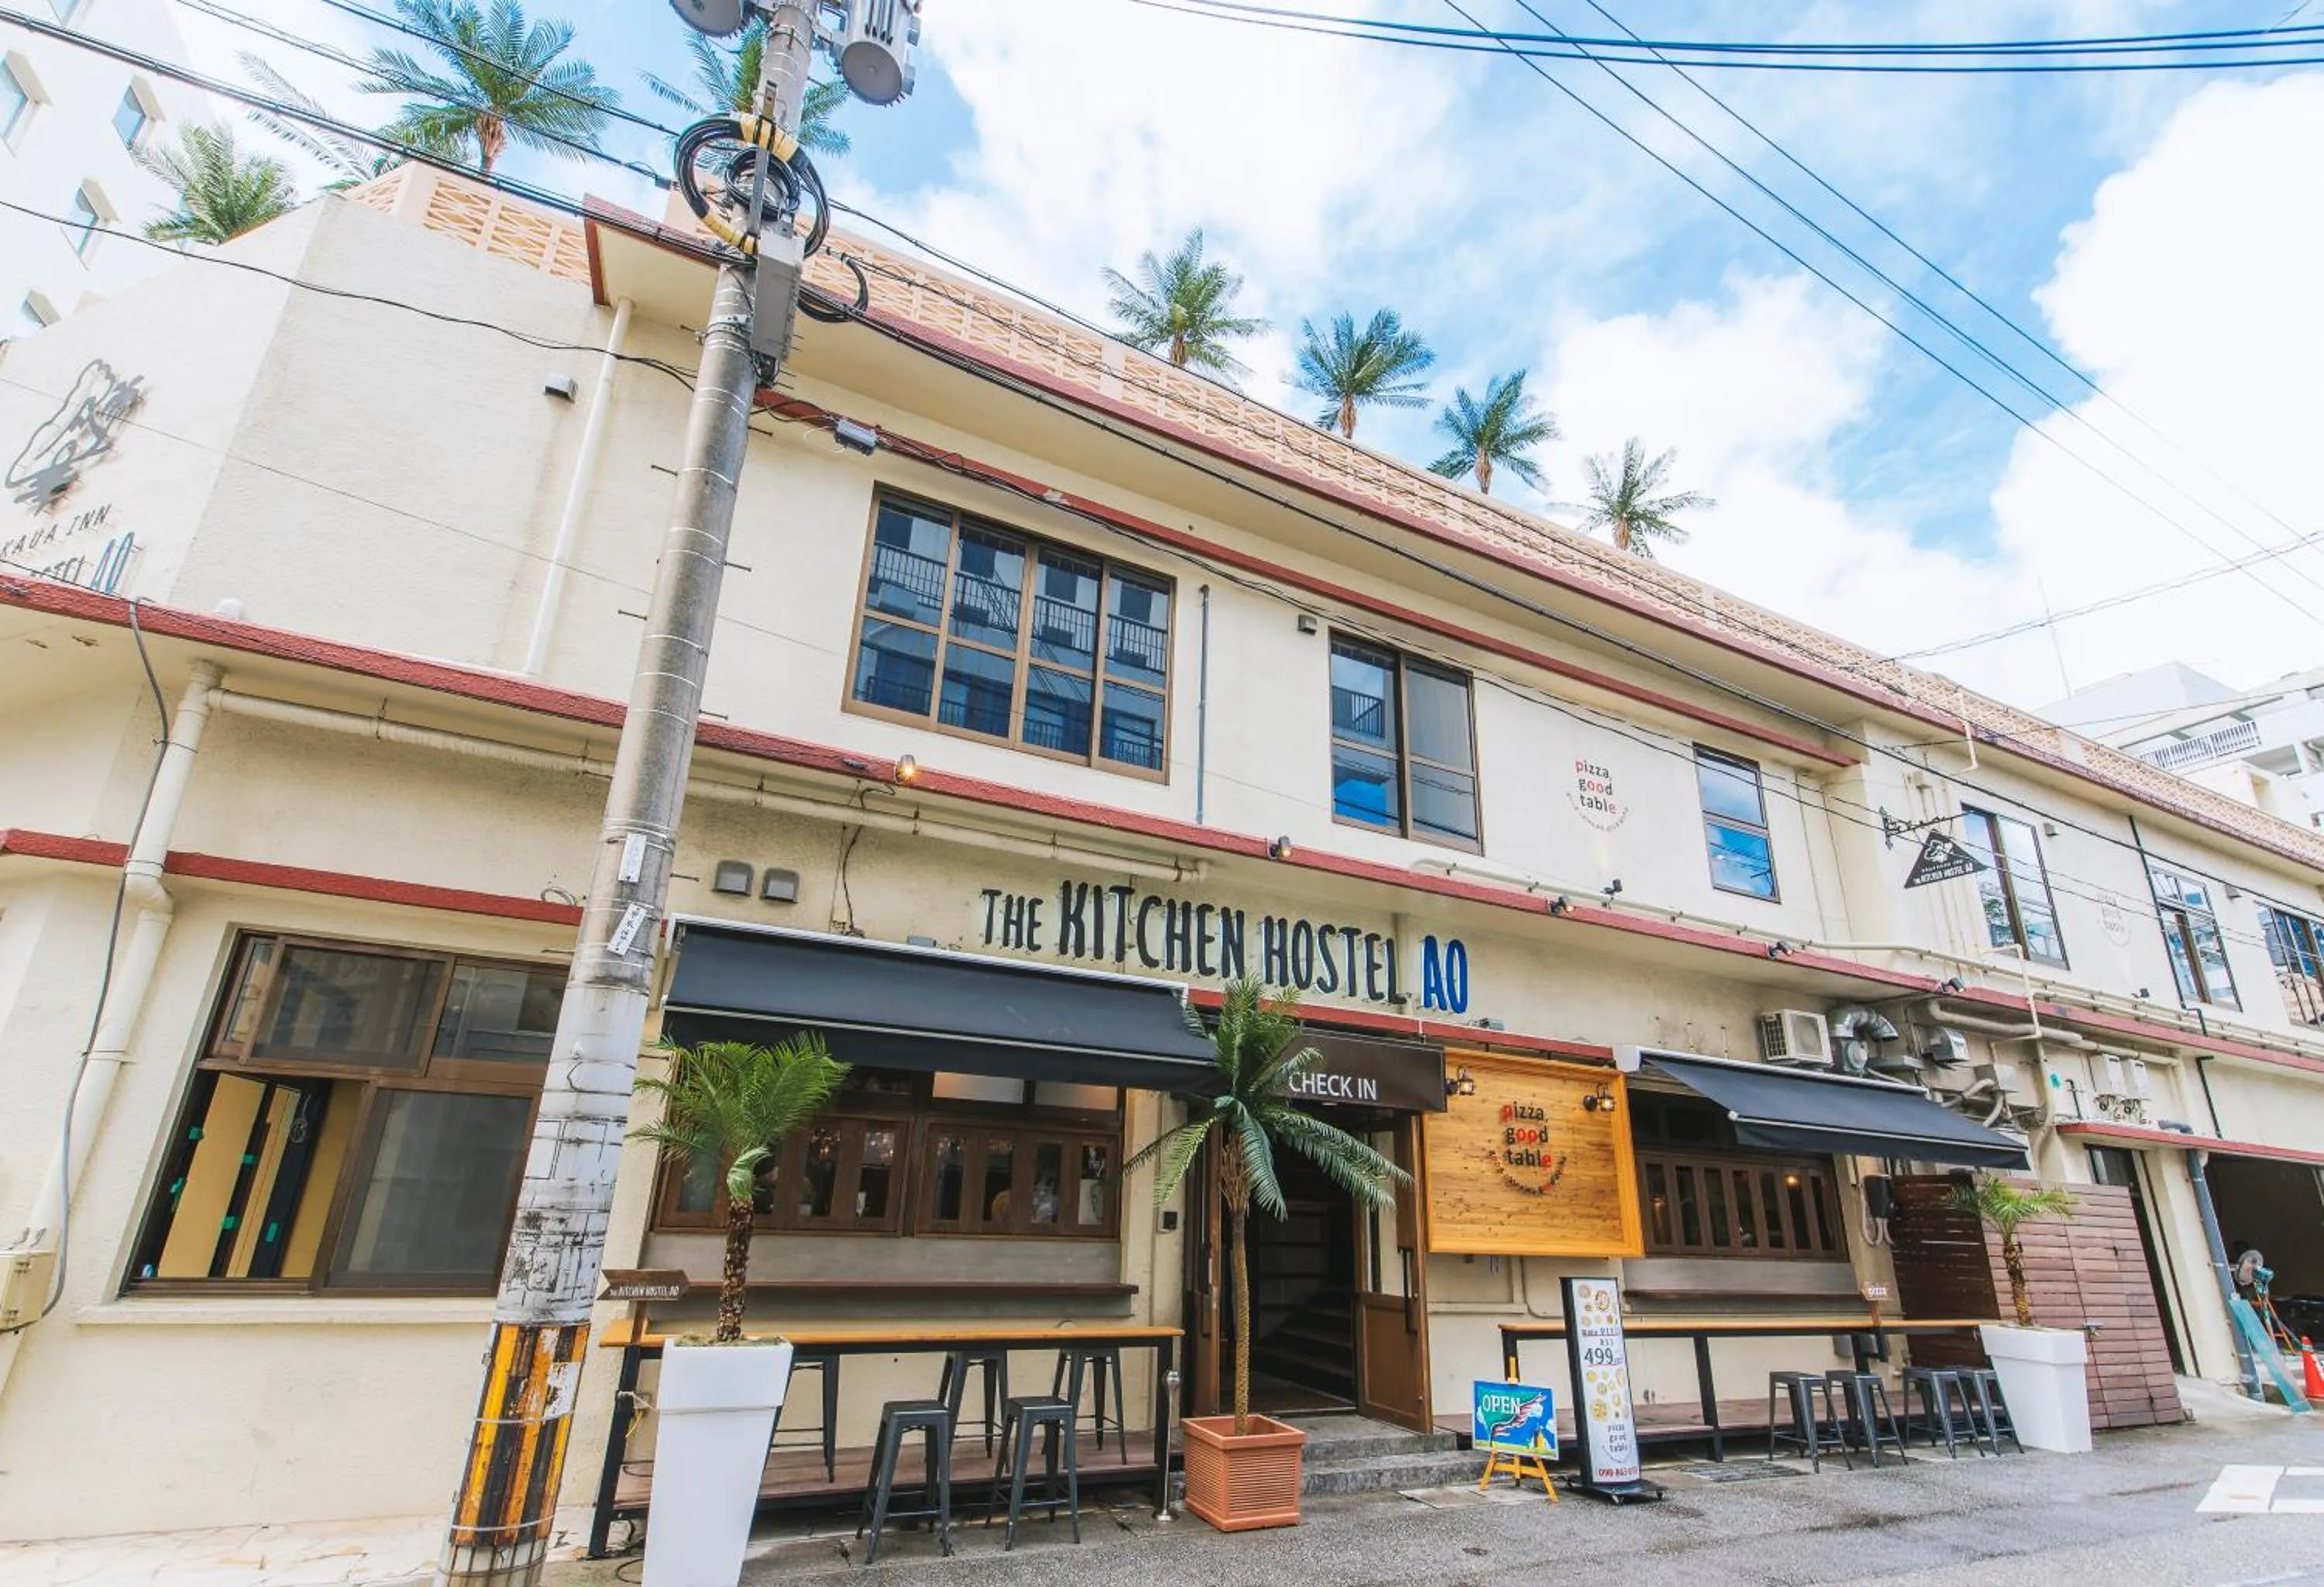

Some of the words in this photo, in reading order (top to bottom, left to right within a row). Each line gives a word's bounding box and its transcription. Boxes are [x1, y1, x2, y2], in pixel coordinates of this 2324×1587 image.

[67, 504, 112, 536] INN
[1578, 778, 1614, 796] good
[1580, 794, 1617, 814] table
[982, 889, 1043, 952] THE
[1059, 880, 1245, 979] KITCHEN
[1261, 915, 1408, 1005] HOSTEL
[1422, 935, 1469, 1014] AO
[1288, 1072, 1353, 1098] CHECK
[1358, 1078, 1377, 1100] IN
[1506, 1125, 1549, 1145] good
[1506, 1148, 1552, 1169] table
[1584, 1348, 1614, 1365] 499
[1482, 1394, 1521, 1414] OPEN
